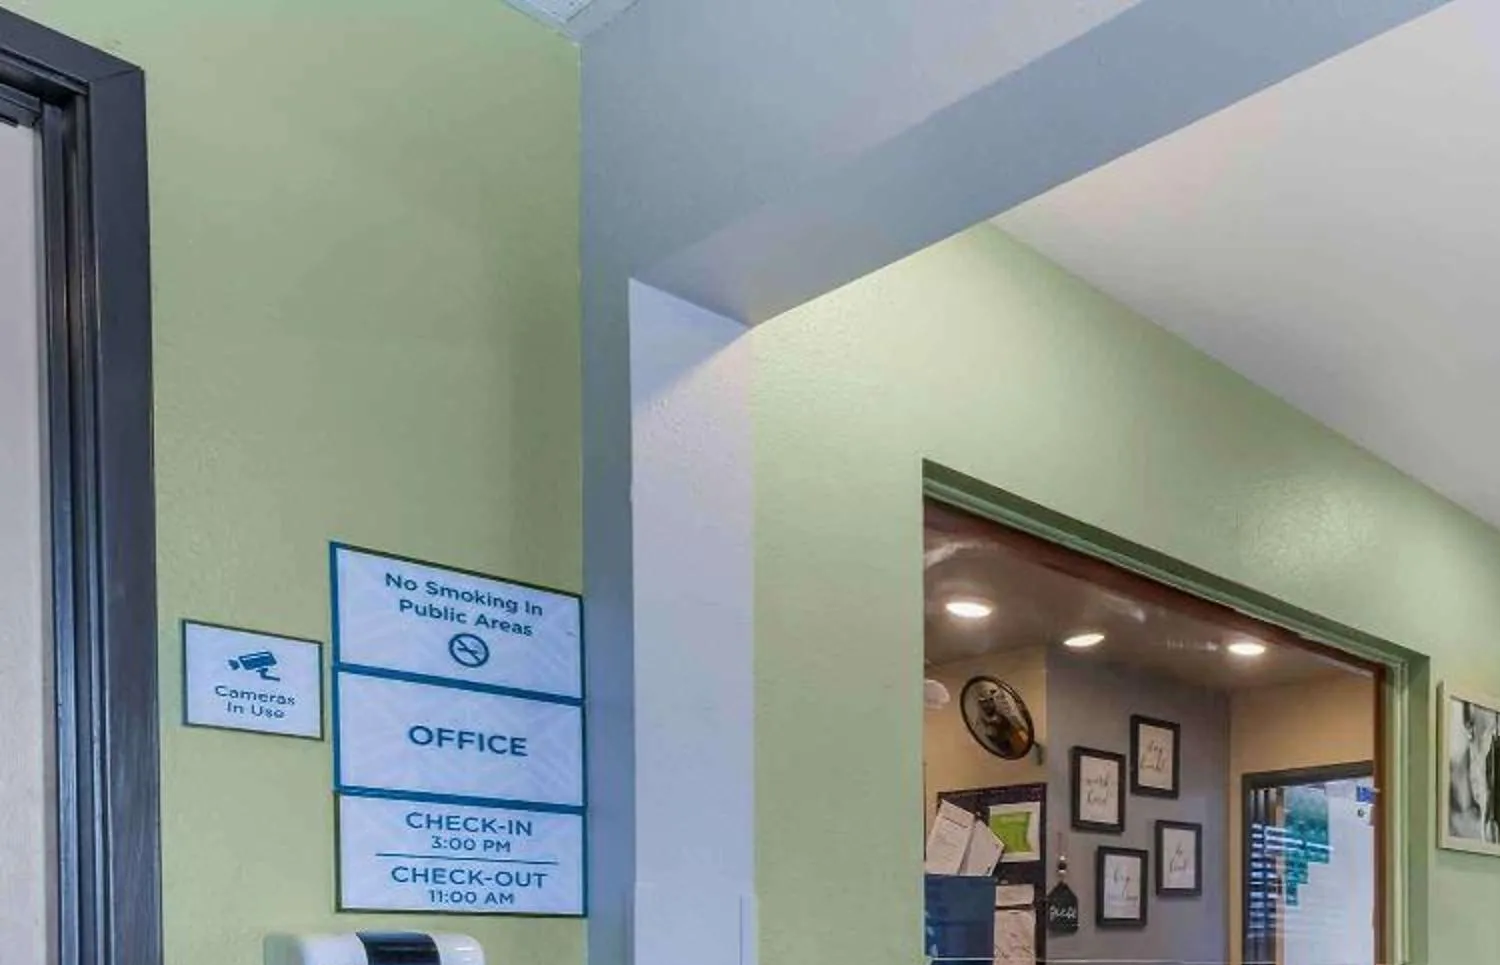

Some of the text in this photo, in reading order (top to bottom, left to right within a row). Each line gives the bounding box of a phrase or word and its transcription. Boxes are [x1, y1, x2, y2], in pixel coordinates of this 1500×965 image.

[385, 572, 543, 617] No Smoking In
[399, 598, 533, 637] Public Areas
[214, 685, 295, 706] Cameras
[226, 700, 285, 719] In Use
[408, 725, 529, 757] OFFICE
[405, 811, 533, 837] CHECK-IN
[431, 835, 511, 853] 3:00 PM
[391, 865, 549, 889] CHECK-OUT
[428, 889, 515, 905] 11:00 AM
